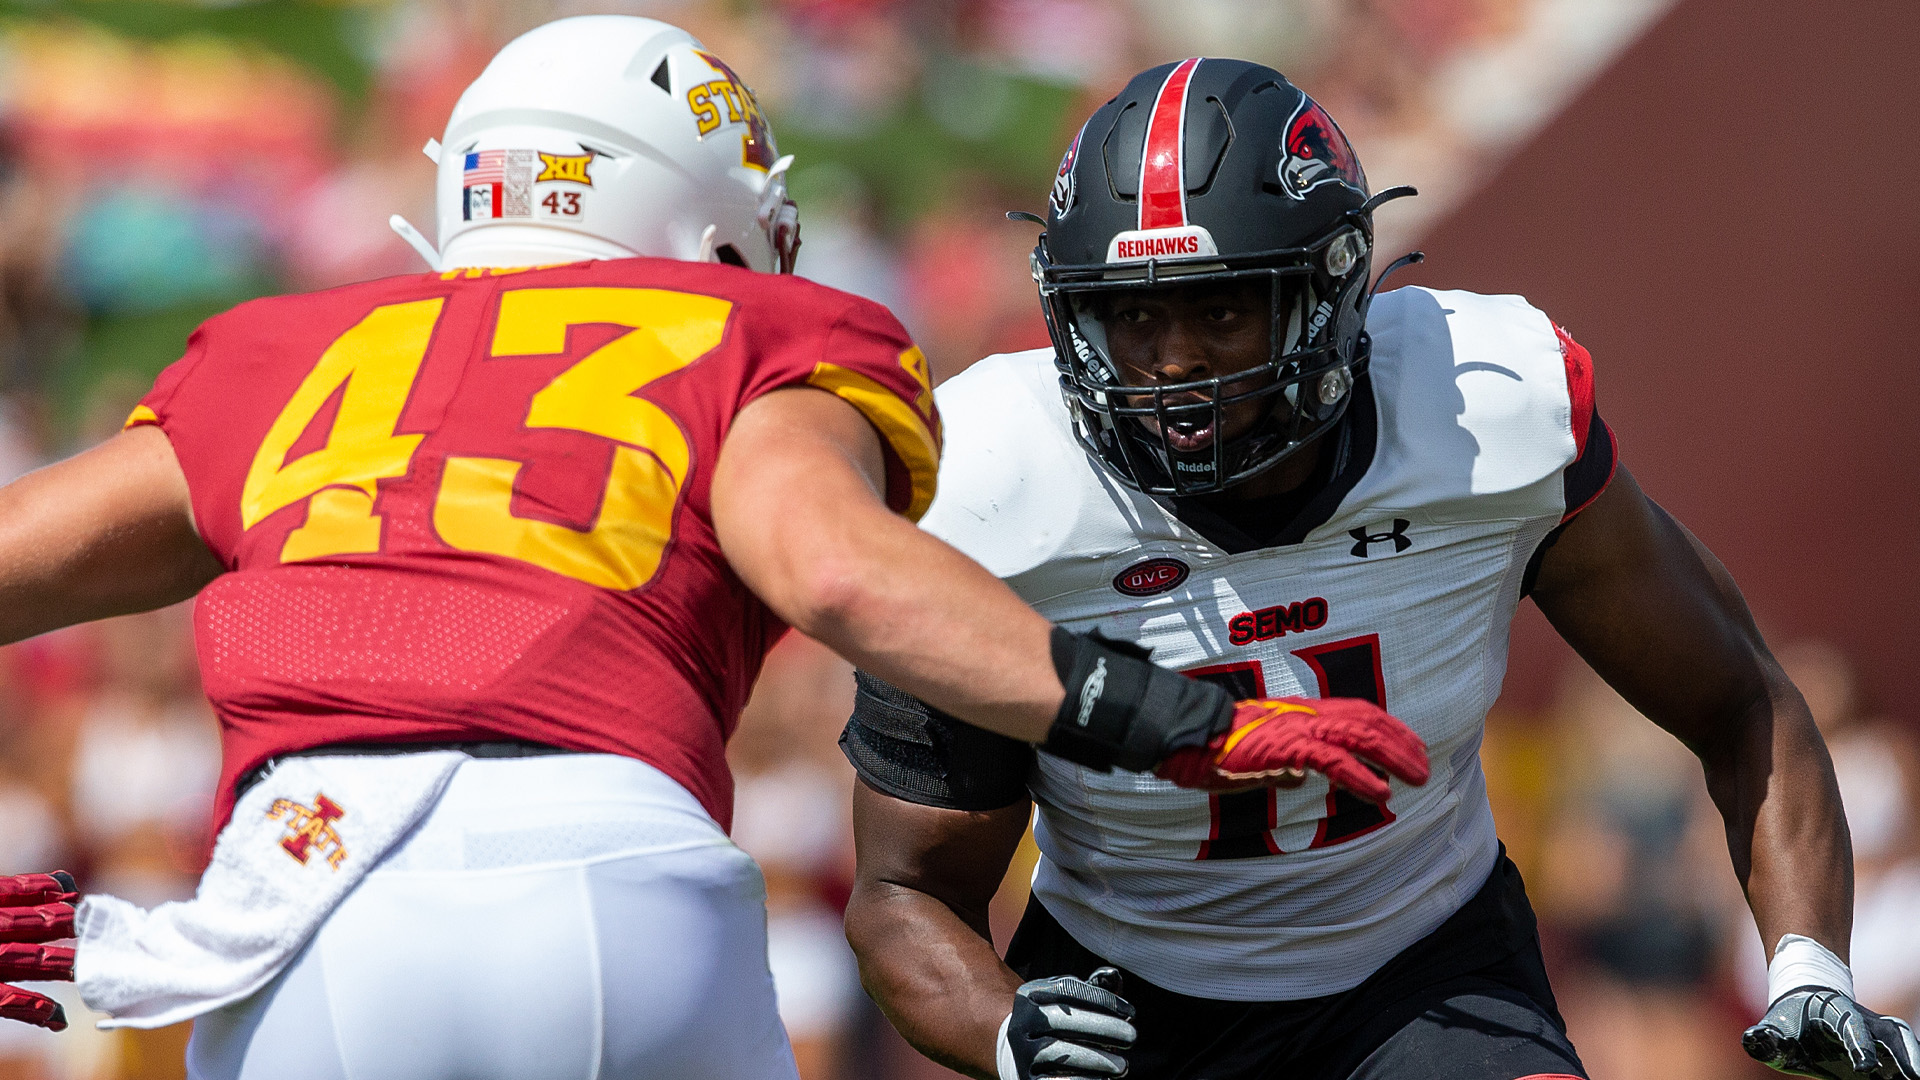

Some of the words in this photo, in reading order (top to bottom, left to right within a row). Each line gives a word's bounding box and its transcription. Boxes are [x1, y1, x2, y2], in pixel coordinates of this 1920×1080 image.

[687, 79, 768, 136] STA
[541, 190, 582, 216] 43
[1117, 235, 1199, 259] REDHAWKS
[240, 286, 734, 592] 43
[1177, 461, 1216, 472] Riddel
[1131, 568, 1169, 587] OVC
[1229, 596, 1328, 646] SEMO
[1178, 633, 1396, 861] 11
[265, 798, 348, 871] STATE
